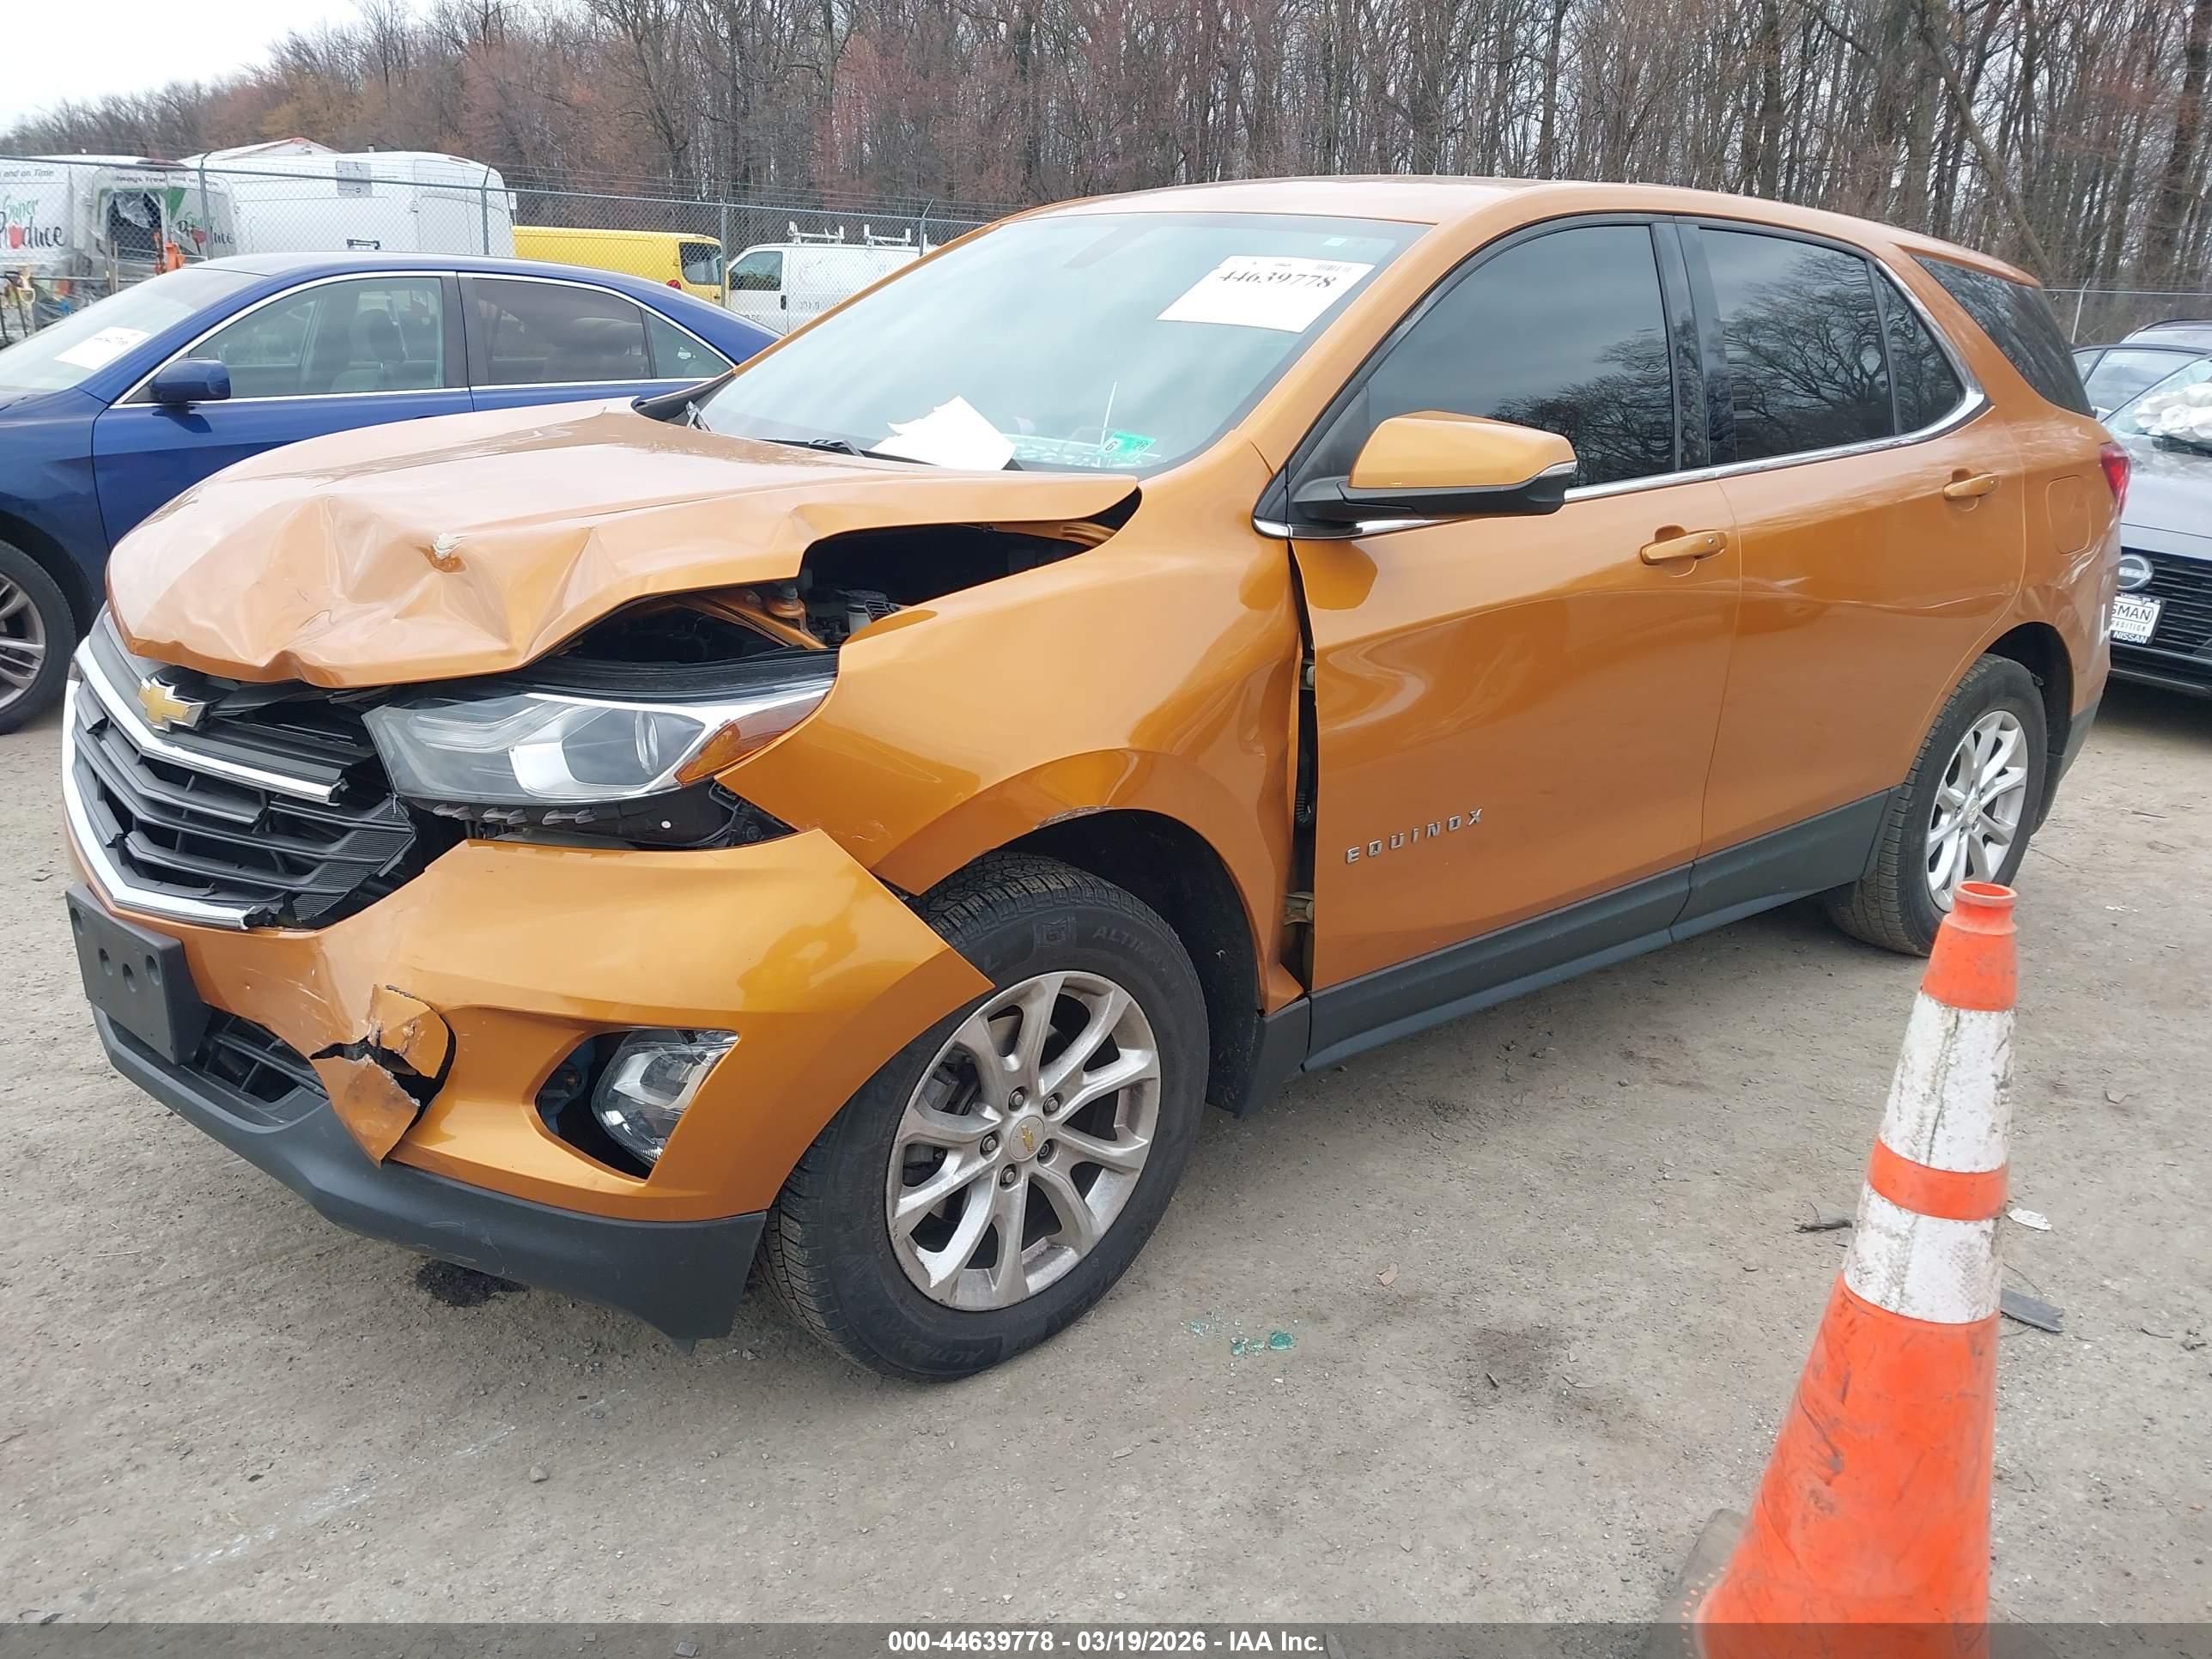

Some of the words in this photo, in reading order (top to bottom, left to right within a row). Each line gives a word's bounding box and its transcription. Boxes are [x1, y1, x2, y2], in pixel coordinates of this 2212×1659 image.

[34, 168, 54, 177] Time
[1218, 270, 1337, 289] 44639778
[2113, 630, 2148, 644] NISSAN
[1346, 808, 1483, 865] EQUINOX
